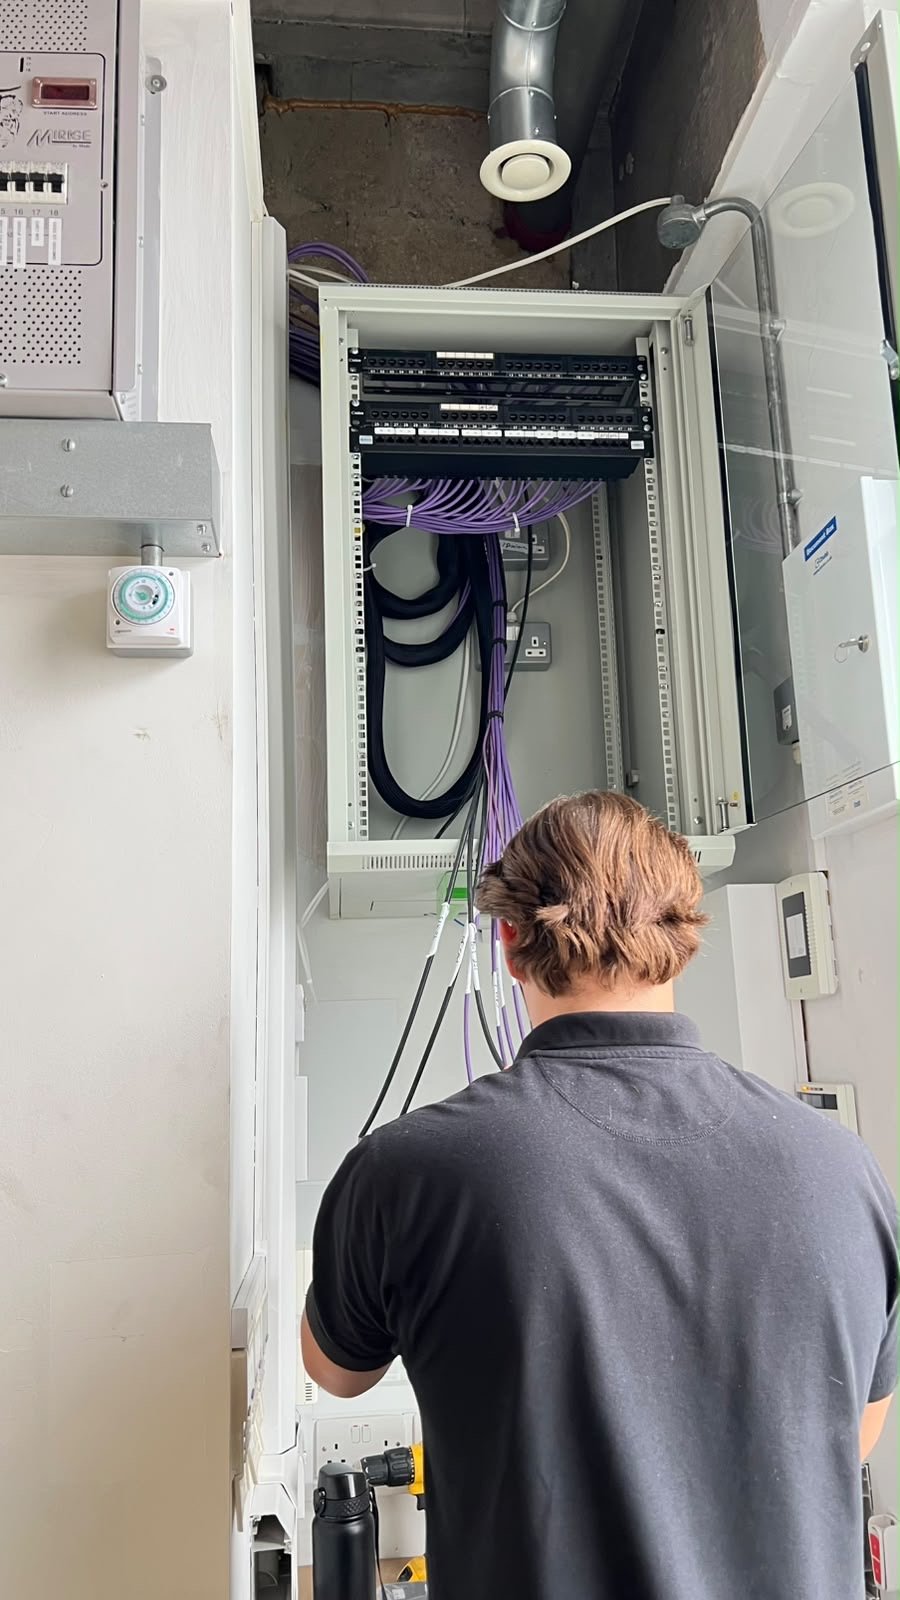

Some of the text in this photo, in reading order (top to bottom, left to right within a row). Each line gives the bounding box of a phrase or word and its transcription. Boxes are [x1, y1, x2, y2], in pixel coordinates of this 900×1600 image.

[14, 208, 24, 216] 16
[32, 208, 41, 216] 17
[49, 209, 59, 217] 18
